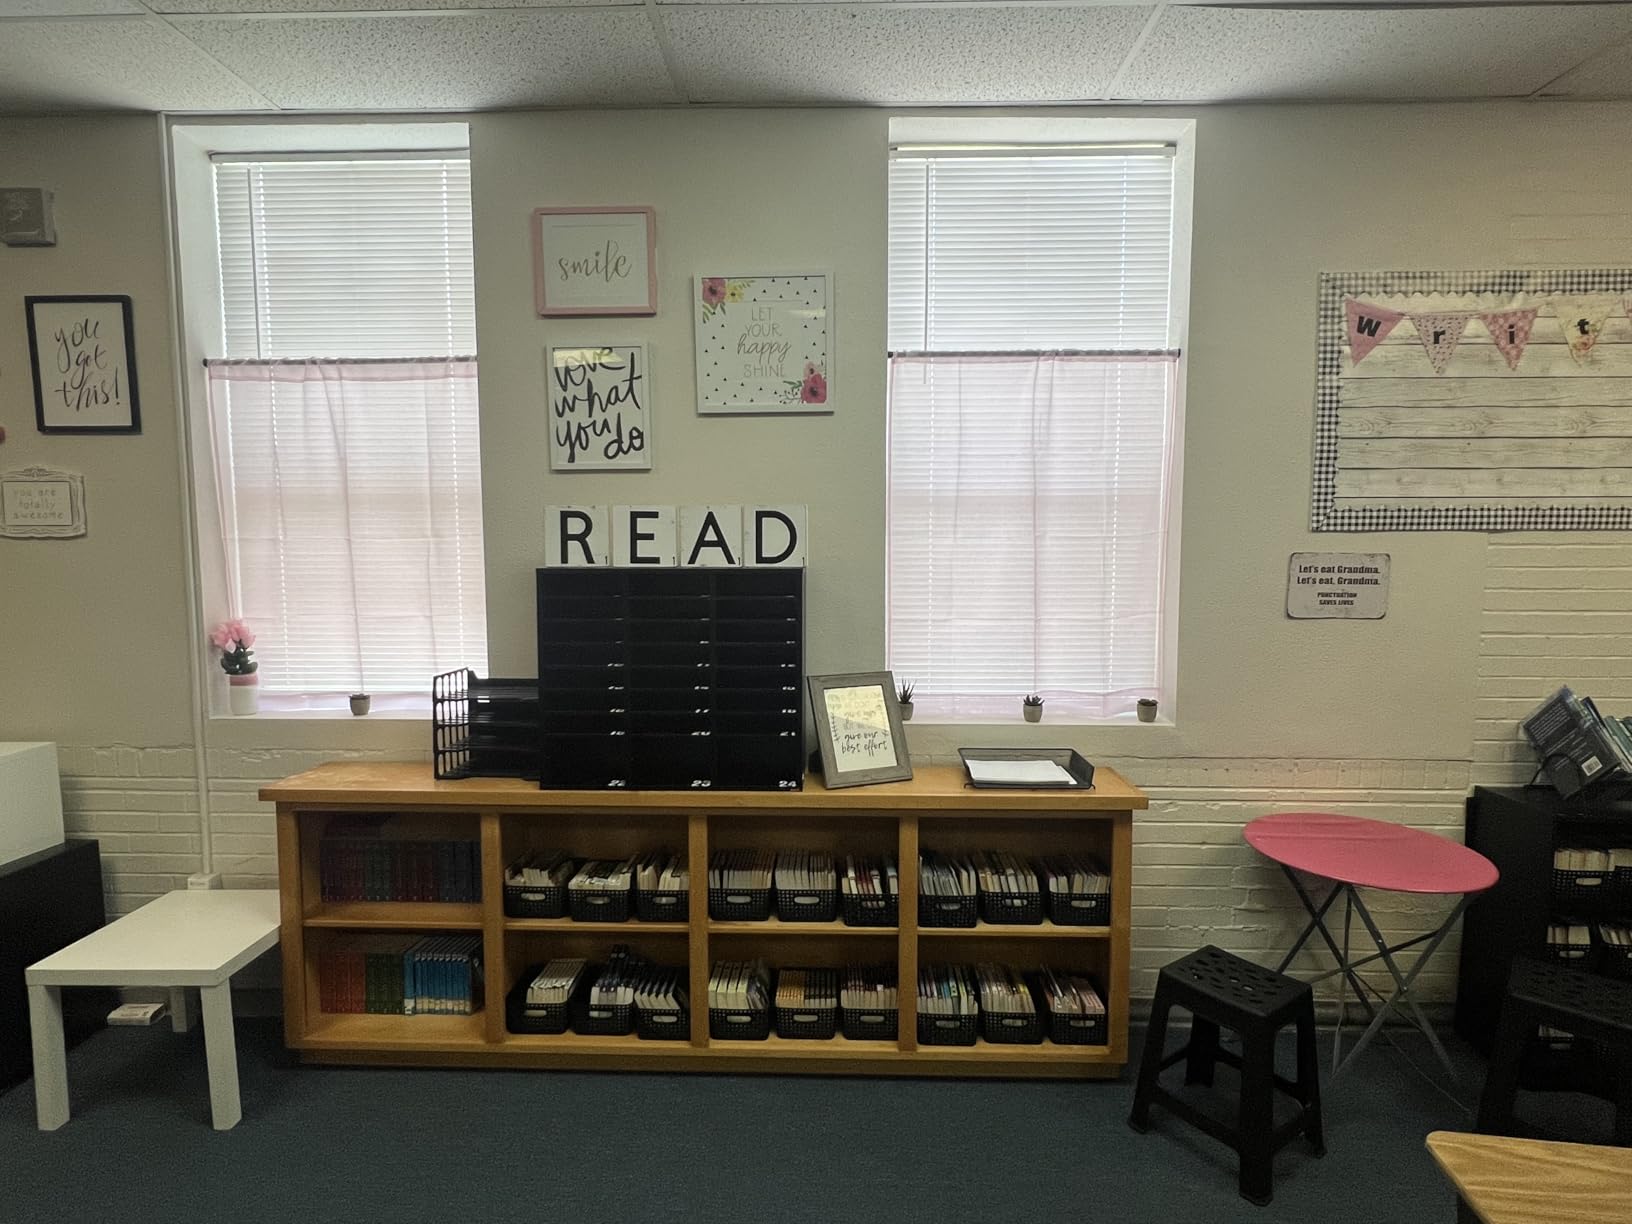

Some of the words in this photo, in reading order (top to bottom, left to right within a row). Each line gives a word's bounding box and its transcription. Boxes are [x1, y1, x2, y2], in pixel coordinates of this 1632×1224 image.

[558, 239, 633, 284] smile
[744, 322, 783, 337] YOUR
[751, 306, 773, 322] LET
[53, 316, 102, 374] you
[736, 333, 792, 365] happy
[71, 347, 107, 390] got
[553, 351, 643, 418] what
[744, 362, 786, 378] SHINE
[54, 368, 121, 412] this!
[556, 418, 612, 463] you
[604, 412, 645, 460] do
[560, 510, 798, 566] READ
[1297, 576, 1317, 585] Let's
[1299, 564, 1319, 574] Let's
[1320, 565, 1336, 574] eat
[841, 741, 861, 755] best
[863, 739, 888, 757] effort
[778, 780, 797, 788] 24
